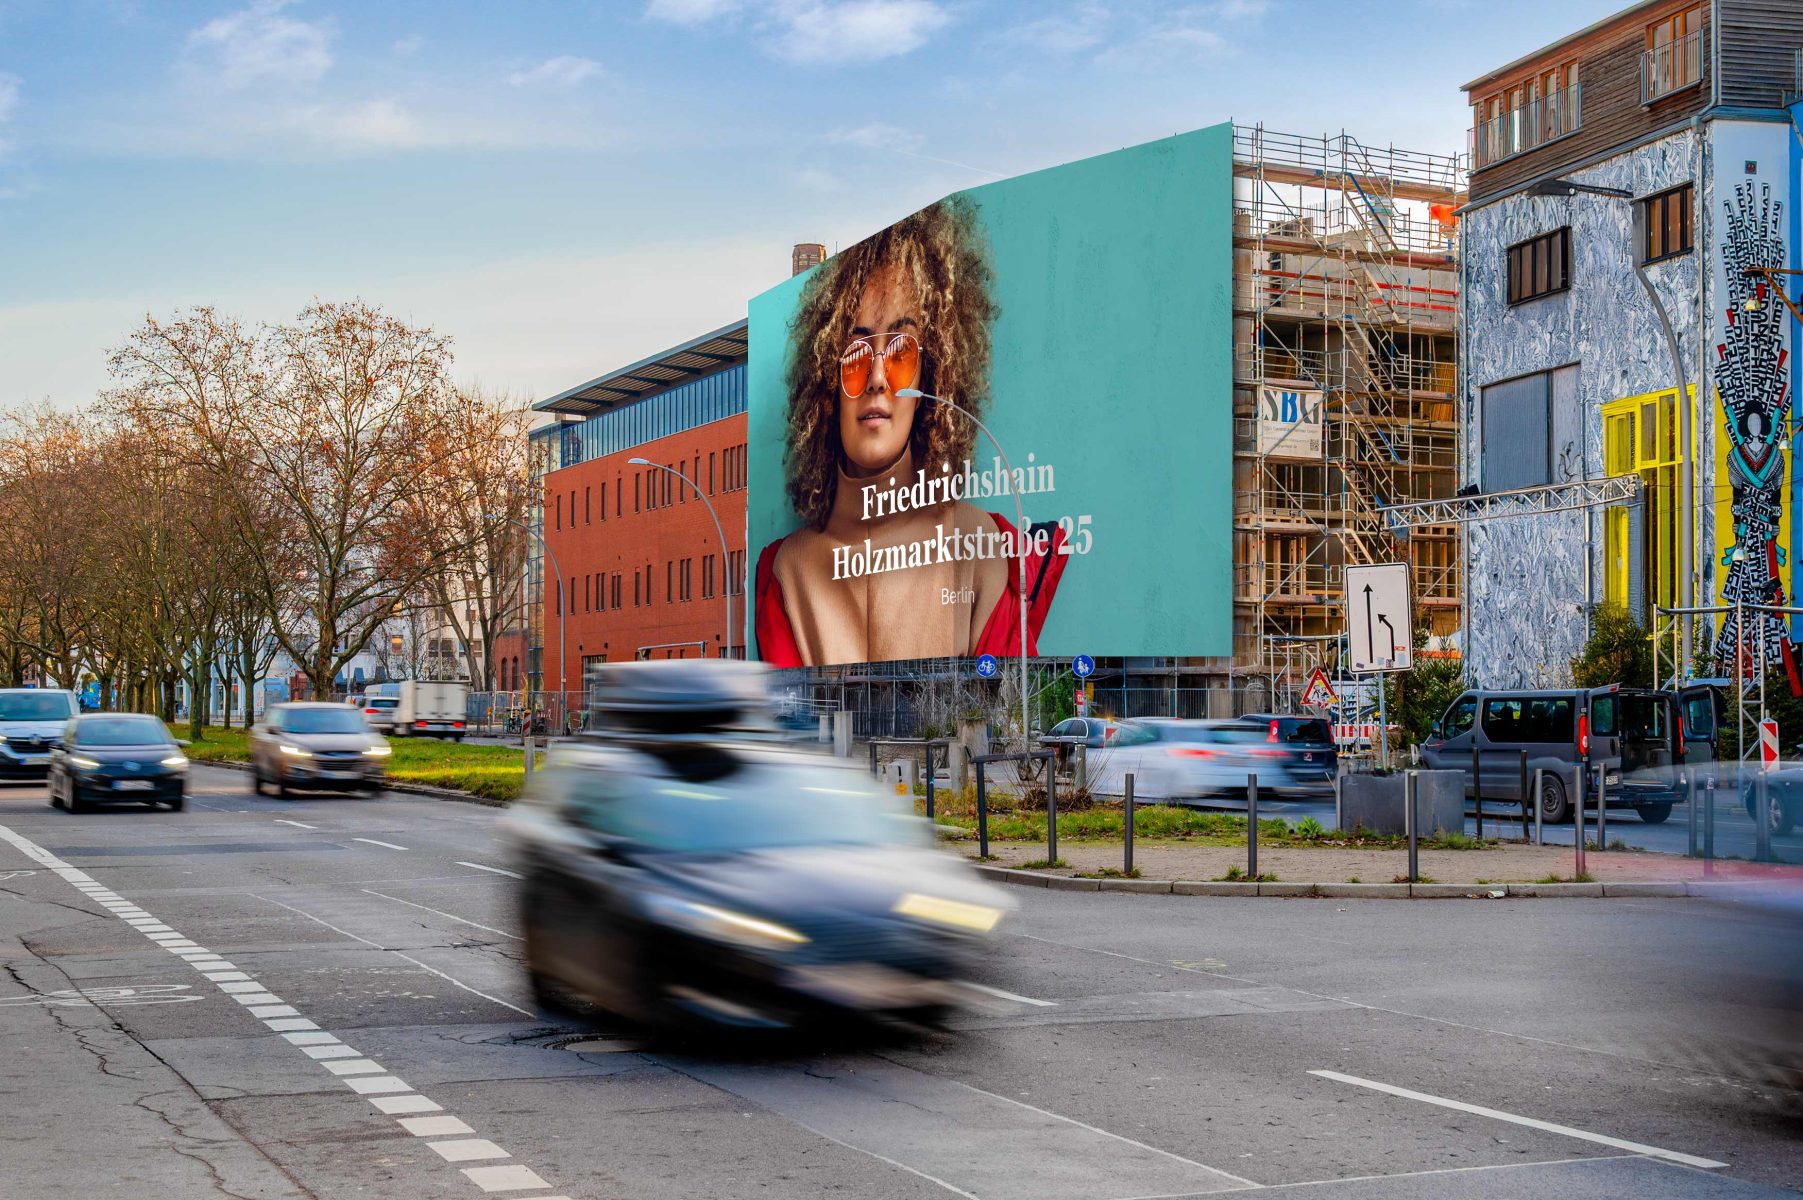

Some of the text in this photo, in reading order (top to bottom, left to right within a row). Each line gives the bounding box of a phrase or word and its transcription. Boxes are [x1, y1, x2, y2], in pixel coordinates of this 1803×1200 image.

[861, 452, 1055, 520] Friedrichshain
[832, 515, 1093, 580] Holzmarktstraße 25
[941, 586, 975, 605] Berlin
